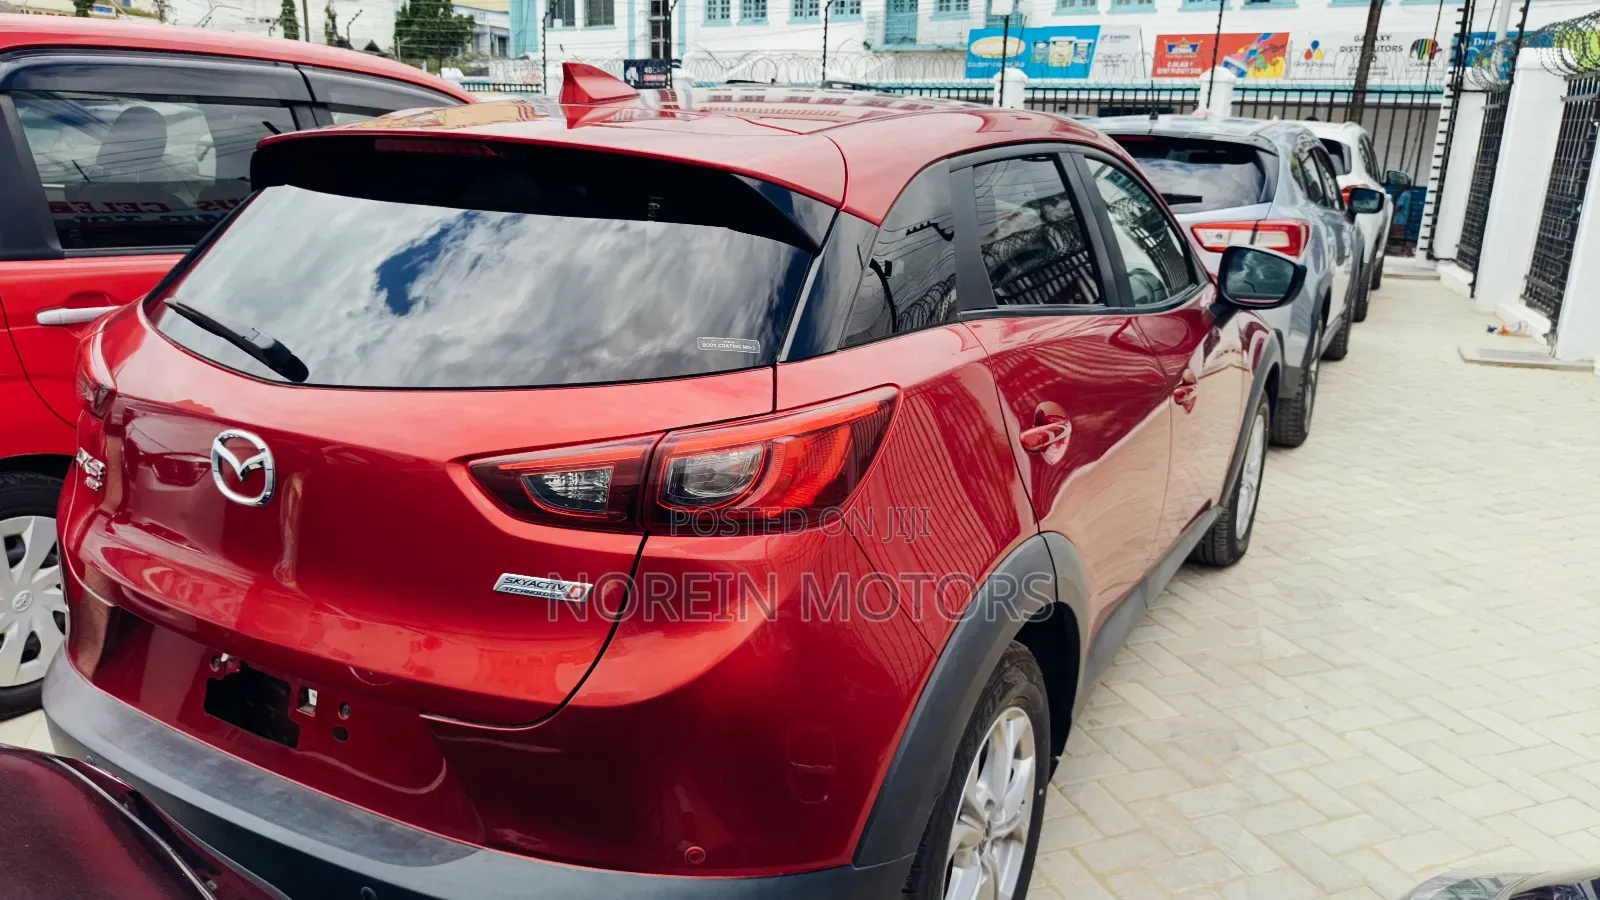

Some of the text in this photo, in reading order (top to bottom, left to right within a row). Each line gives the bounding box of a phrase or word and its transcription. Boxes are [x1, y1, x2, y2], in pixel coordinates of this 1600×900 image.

[1353, 34, 1392, 42] GAXY
[1339, 45, 1404, 53] DISTUTORS
[503, 577, 568, 592] SKYACTIV
[504, 586, 562, 598] TECHNOLOGY
